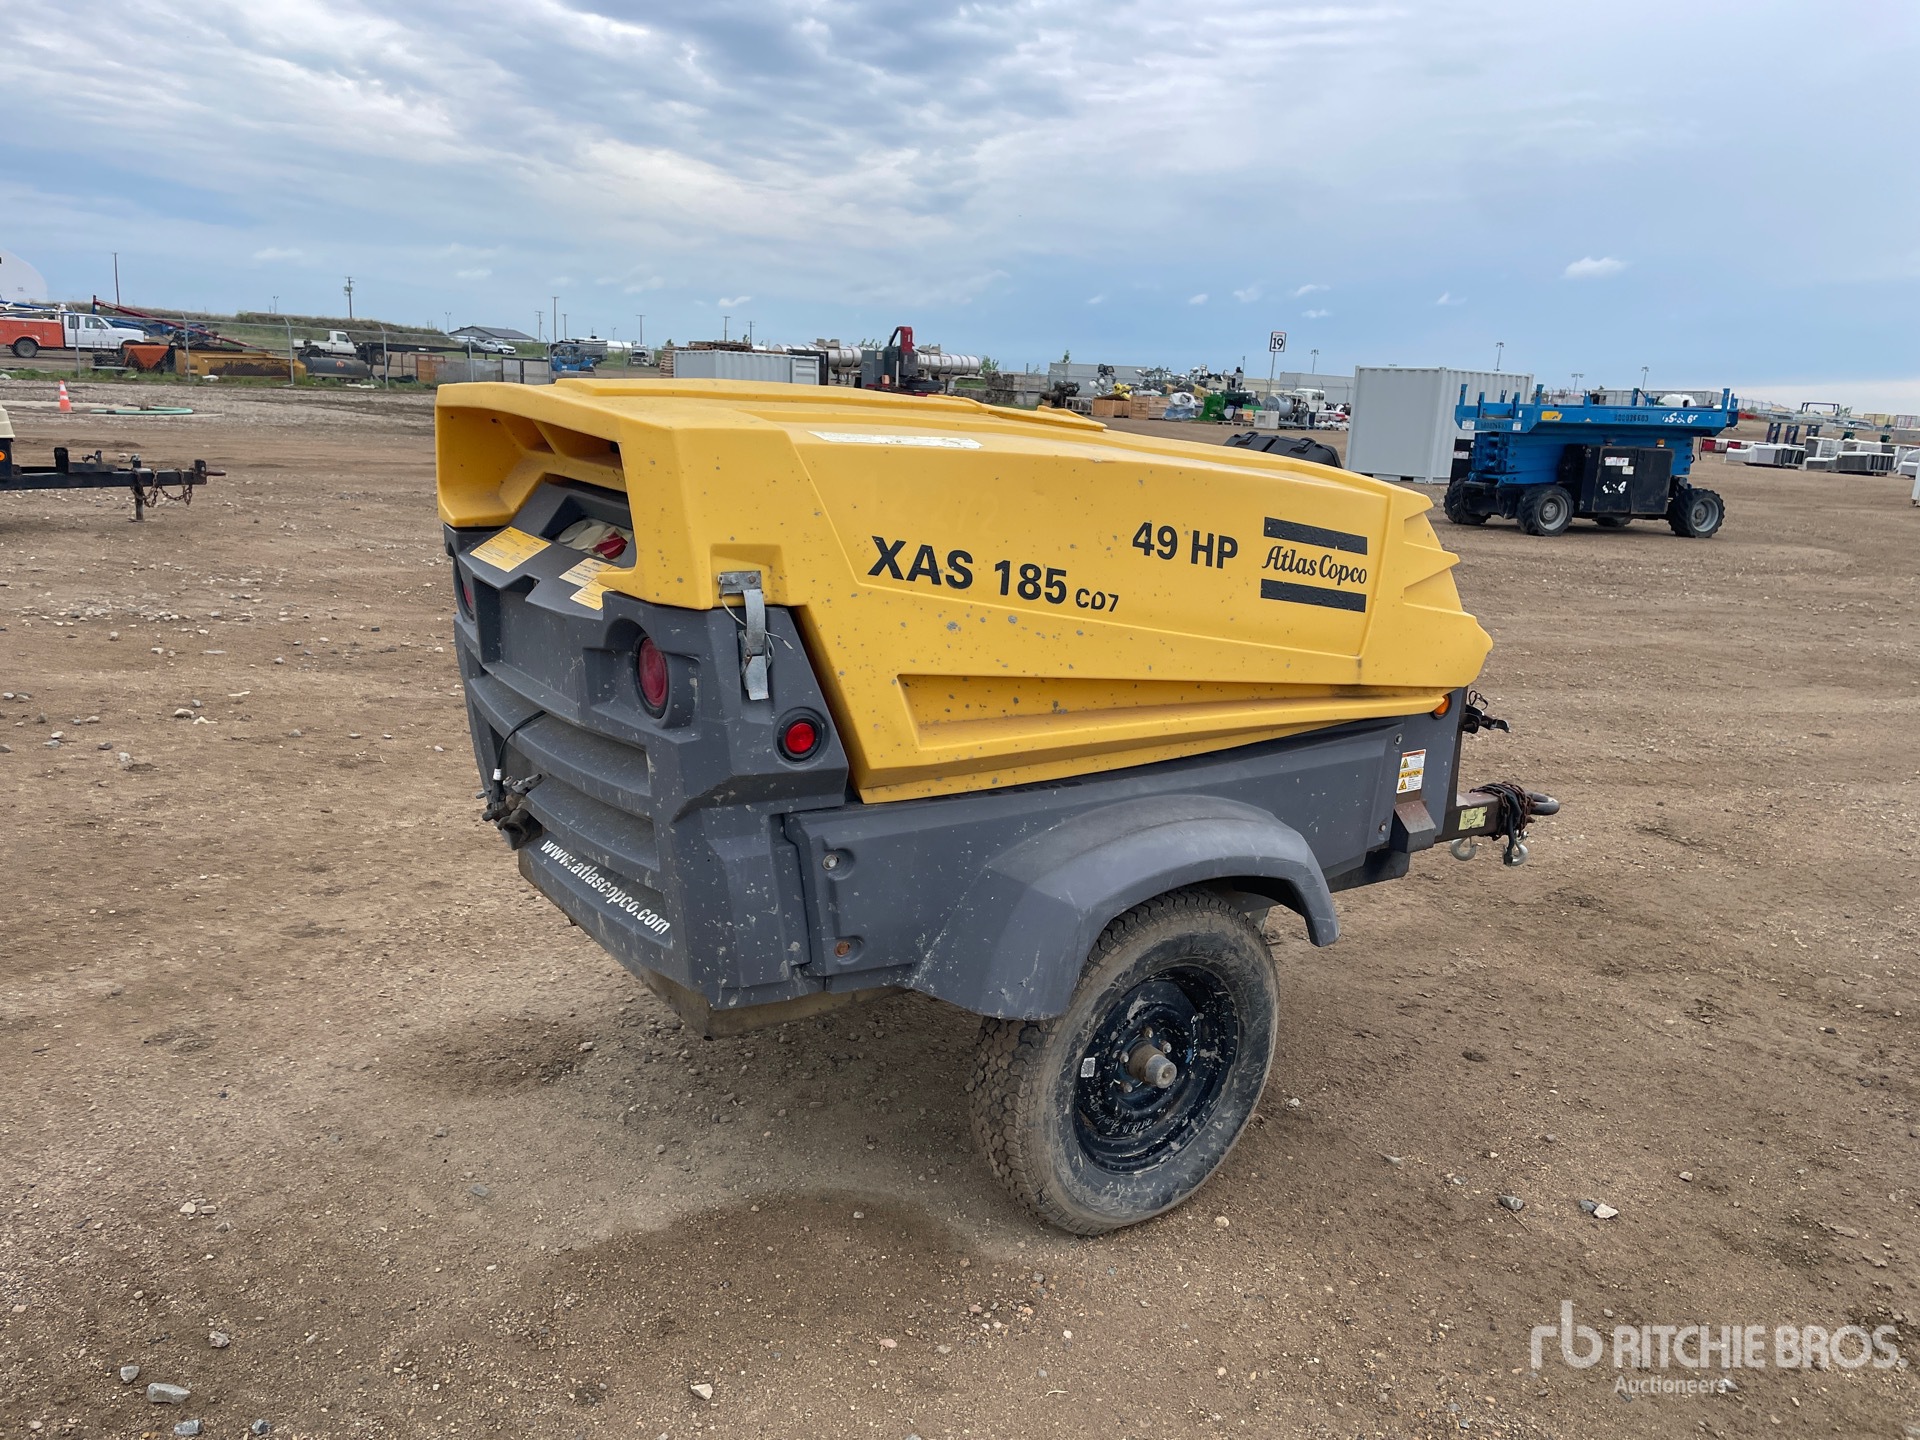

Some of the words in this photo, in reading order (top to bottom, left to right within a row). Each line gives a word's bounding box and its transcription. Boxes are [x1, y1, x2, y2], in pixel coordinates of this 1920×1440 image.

[1272, 338, 1284, 350] 19
[1132, 522, 1178, 561] 49
[1190, 530, 1239, 569] HP
[1262, 545, 1318, 577] Atlas
[1318, 554, 1367, 586] Copco
[867, 535, 974, 590] XAS
[994, 560, 1067, 605] 185
[540, 839, 671, 935] www.atlascopco.com
